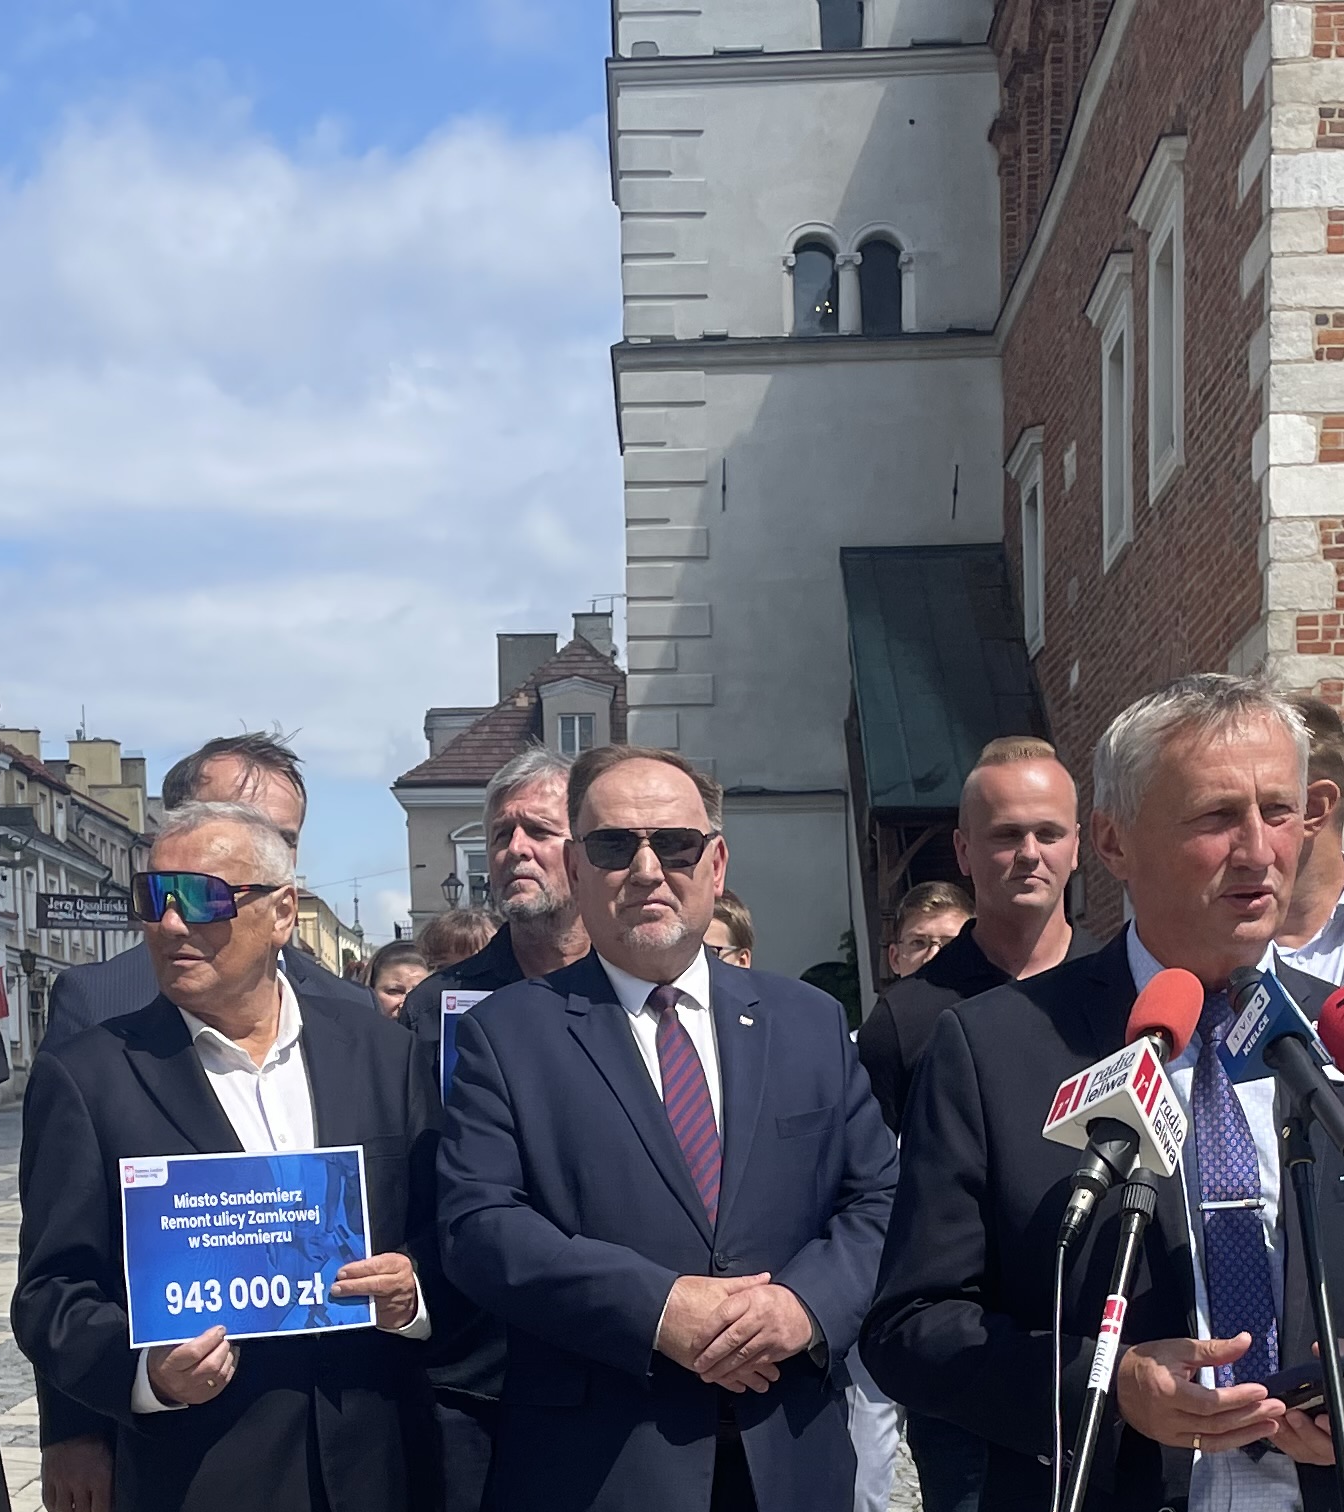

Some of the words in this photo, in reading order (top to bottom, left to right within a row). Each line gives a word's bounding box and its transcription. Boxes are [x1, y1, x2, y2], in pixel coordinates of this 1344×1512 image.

[48, 897, 74, 911] Jerzy
[1243, 1014, 1269, 1056] KIELCE
[1092, 1052, 1136, 1086] radio
[1084, 1072, 1128, 1105] leliwa
[1159, 1096, 1183, 1142] radio
[1152, 1110, 1176, 1166] leliwa
[174, 1192, 218, 1208] Miasto
[220, 1188, 302, 1206] Sandomierz
[161, 1214, 211, 1230] Remont
[214, 1210, 246, 1228] ulicy
[248, 1205, 319, 1224] Zamkowej
[189, 1238, 200, 1248] w
[202, 1230, 292, 1247] Sandomierzu
[166, 1279, 222, 1314] 943
[229, 1274, 290, 1310] 000
[298, 1272, 324, 1306] zł
